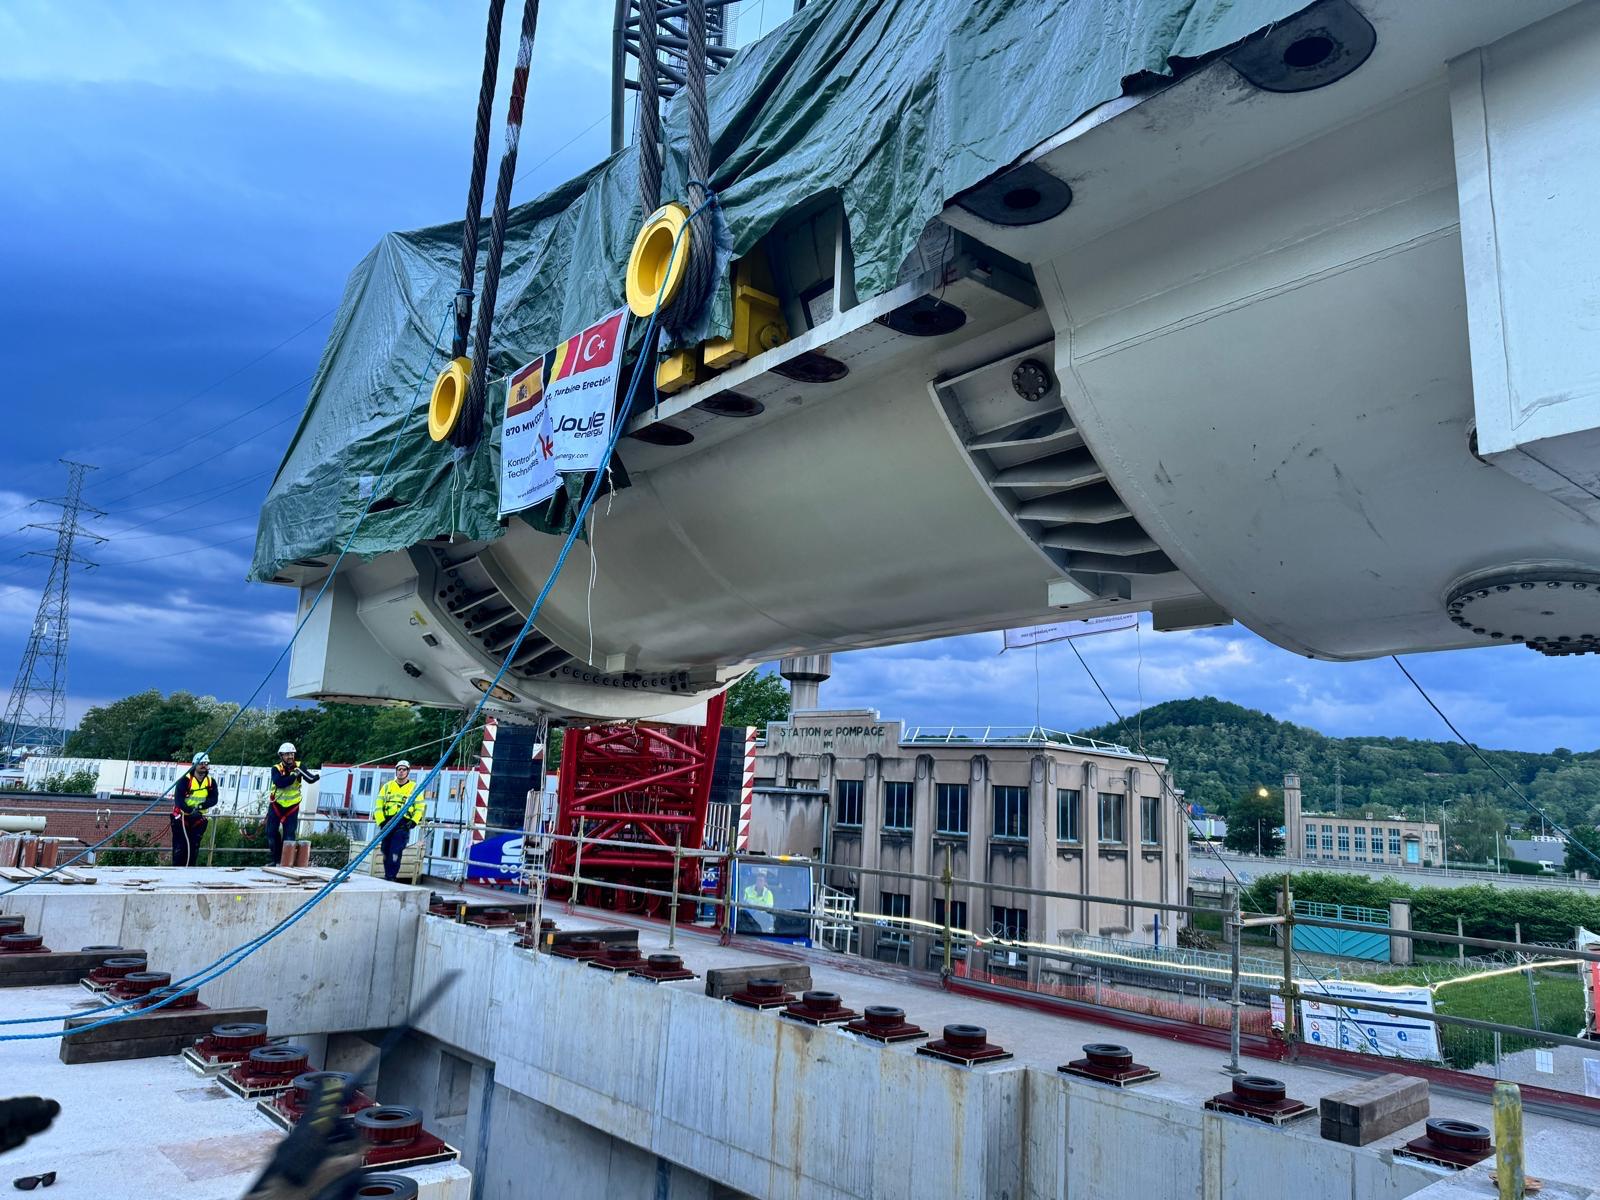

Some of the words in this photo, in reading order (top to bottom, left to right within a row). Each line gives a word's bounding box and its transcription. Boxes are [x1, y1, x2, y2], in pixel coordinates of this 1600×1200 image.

[505, 425, 521, 436] 870
[554, 384, 581, 397] Turbine
[554, 411, 606, 433] Joule
[573, 427, 604, 438] energy
[780, 727, 821, 737] STATION
[835, 726, 885, 737] POMPAGE
